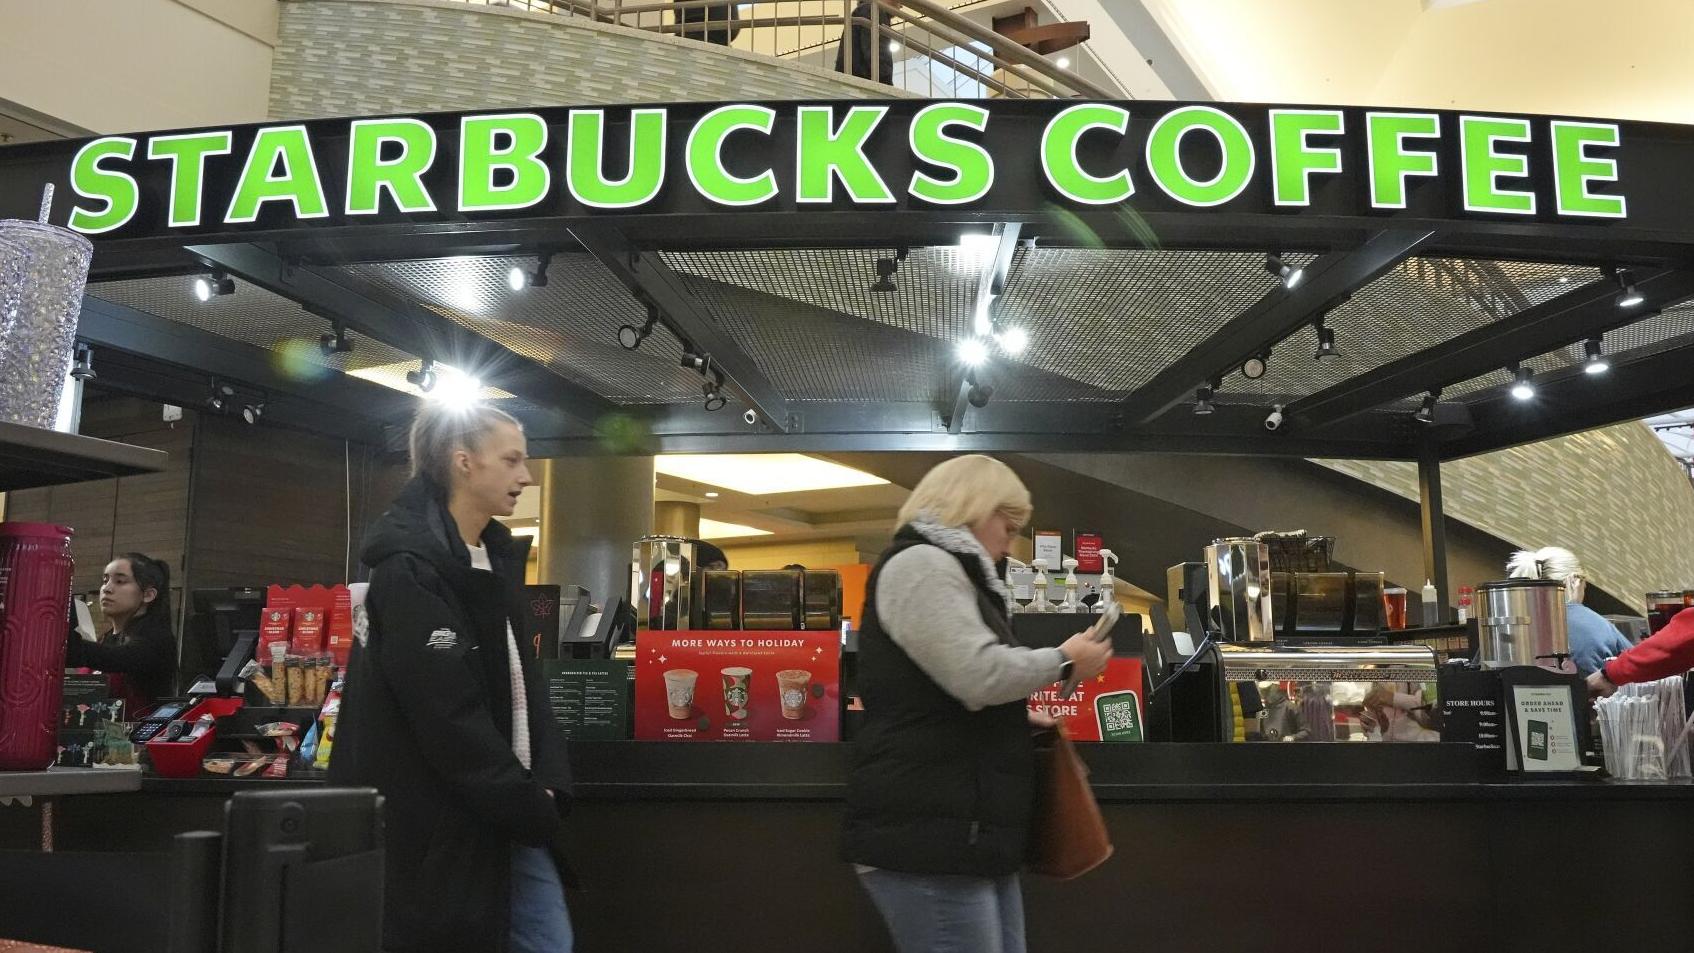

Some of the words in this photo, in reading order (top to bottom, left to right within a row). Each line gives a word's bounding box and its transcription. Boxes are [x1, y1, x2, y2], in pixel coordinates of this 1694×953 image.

[68, 102, 995, 234] STARBUCKS
[1041, 103, 1627, 218] COFFEE
[671, 639, 703, 647] MORE
[706, 639, 737, 647] WAYS
[740, 639, 754, 647] TO
[757, 639, 805, 647] HOLIDAY
[1068, 691, 1085, 702] AT
[1035, 704, 1078, 716] STORE
